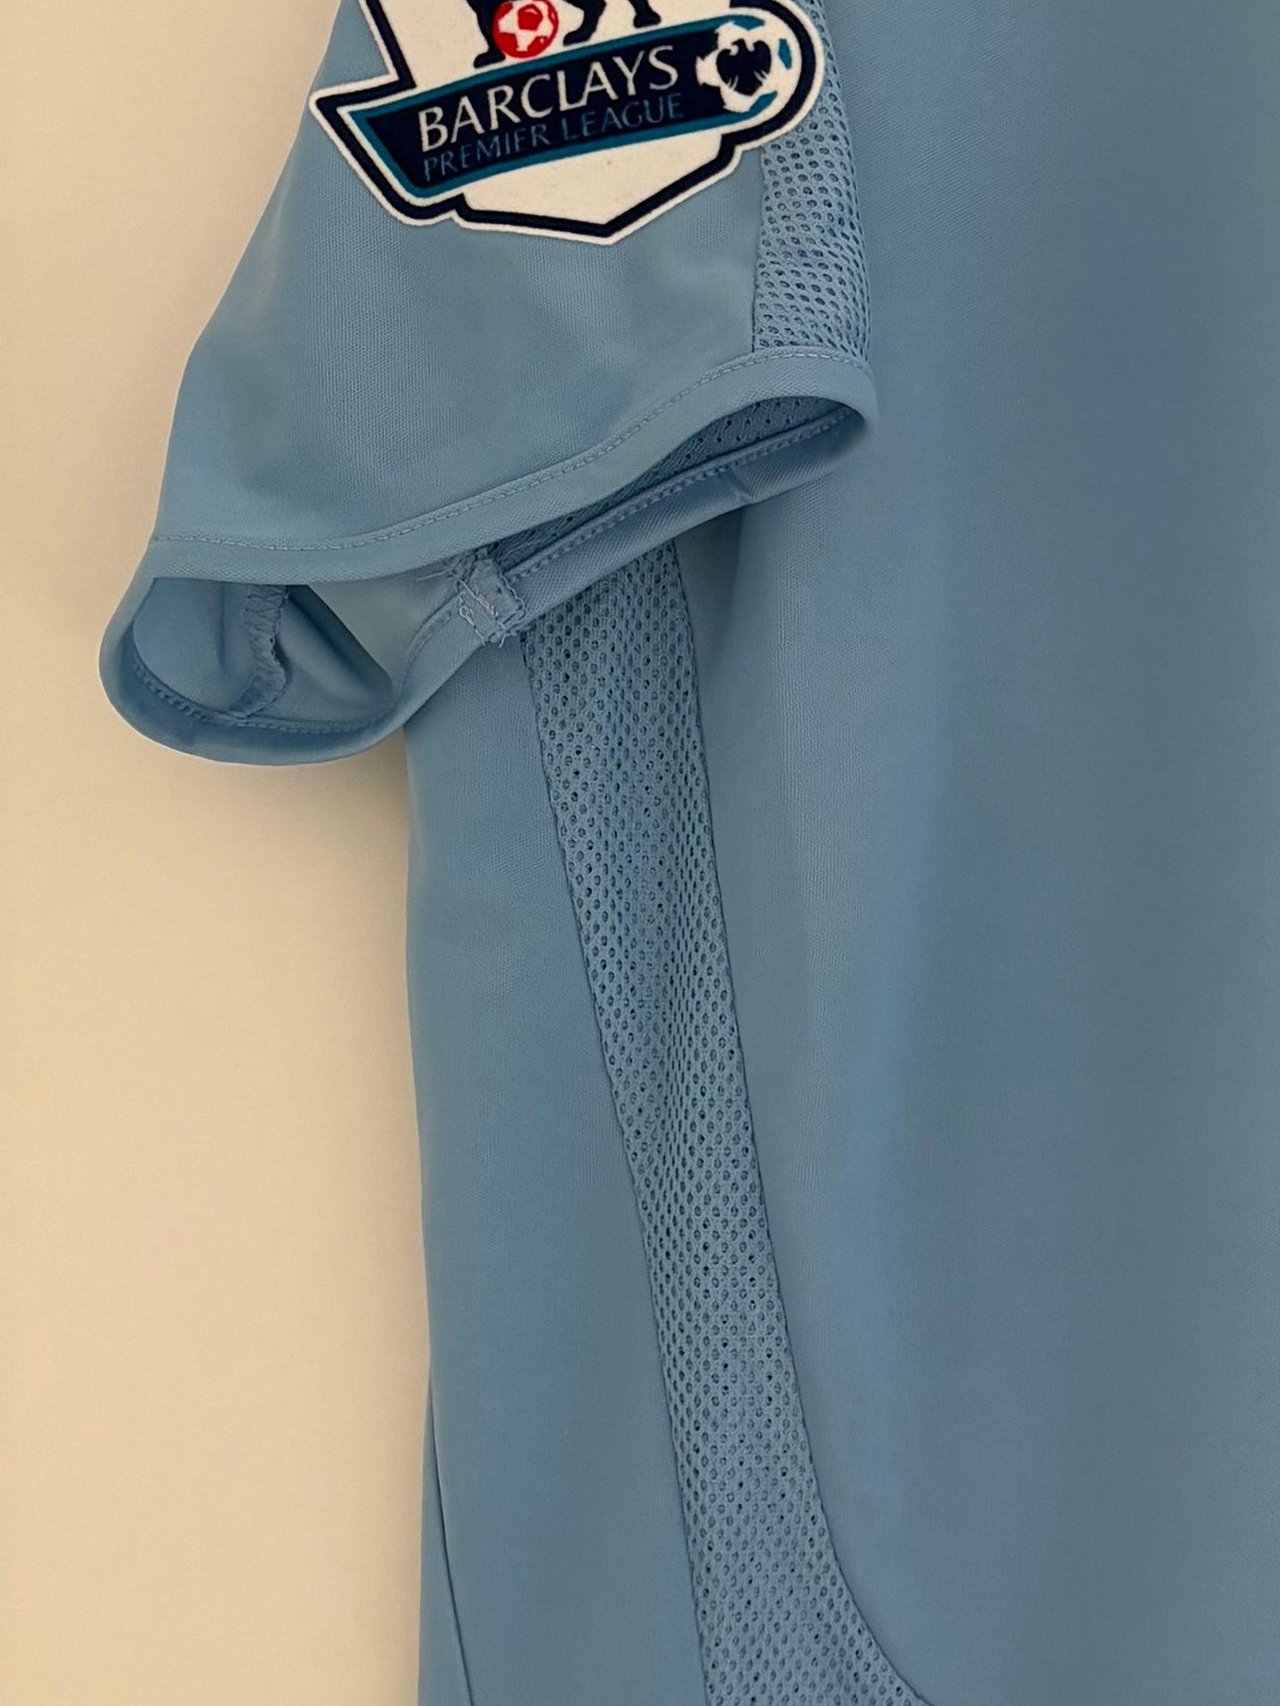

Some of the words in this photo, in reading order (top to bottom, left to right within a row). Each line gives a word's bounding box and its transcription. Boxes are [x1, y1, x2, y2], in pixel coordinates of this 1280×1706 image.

[418, 46, 678, 152] BARCLAYS
[422, 124, 551, 182] PREMIER
[562, 95, 684, 141] LEAGUE
